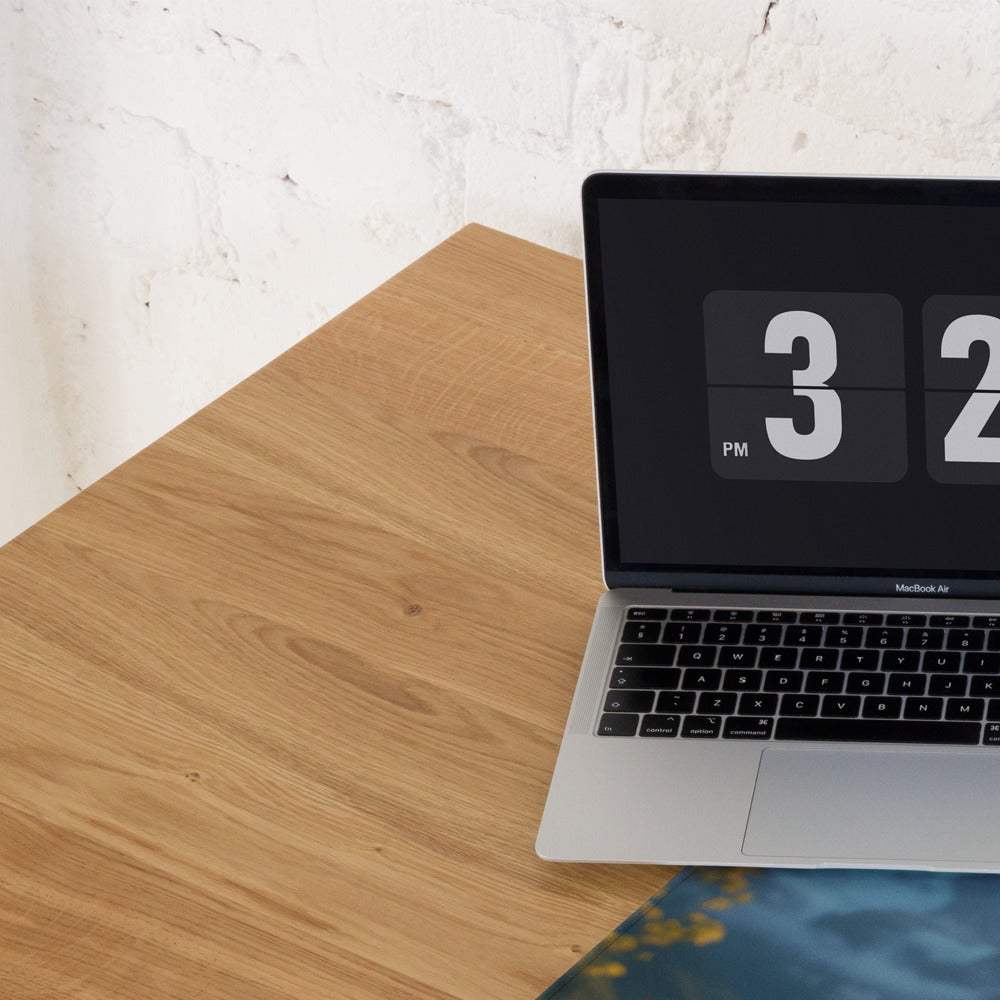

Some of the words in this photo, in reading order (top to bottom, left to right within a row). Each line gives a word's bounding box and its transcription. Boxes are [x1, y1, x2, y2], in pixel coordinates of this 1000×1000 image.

[764, 310, 843, 460] 3
[723, 441, 749, 457] PM
[895, 583, 936, 593] MacBook
[937, 584, 950, 593] Air
